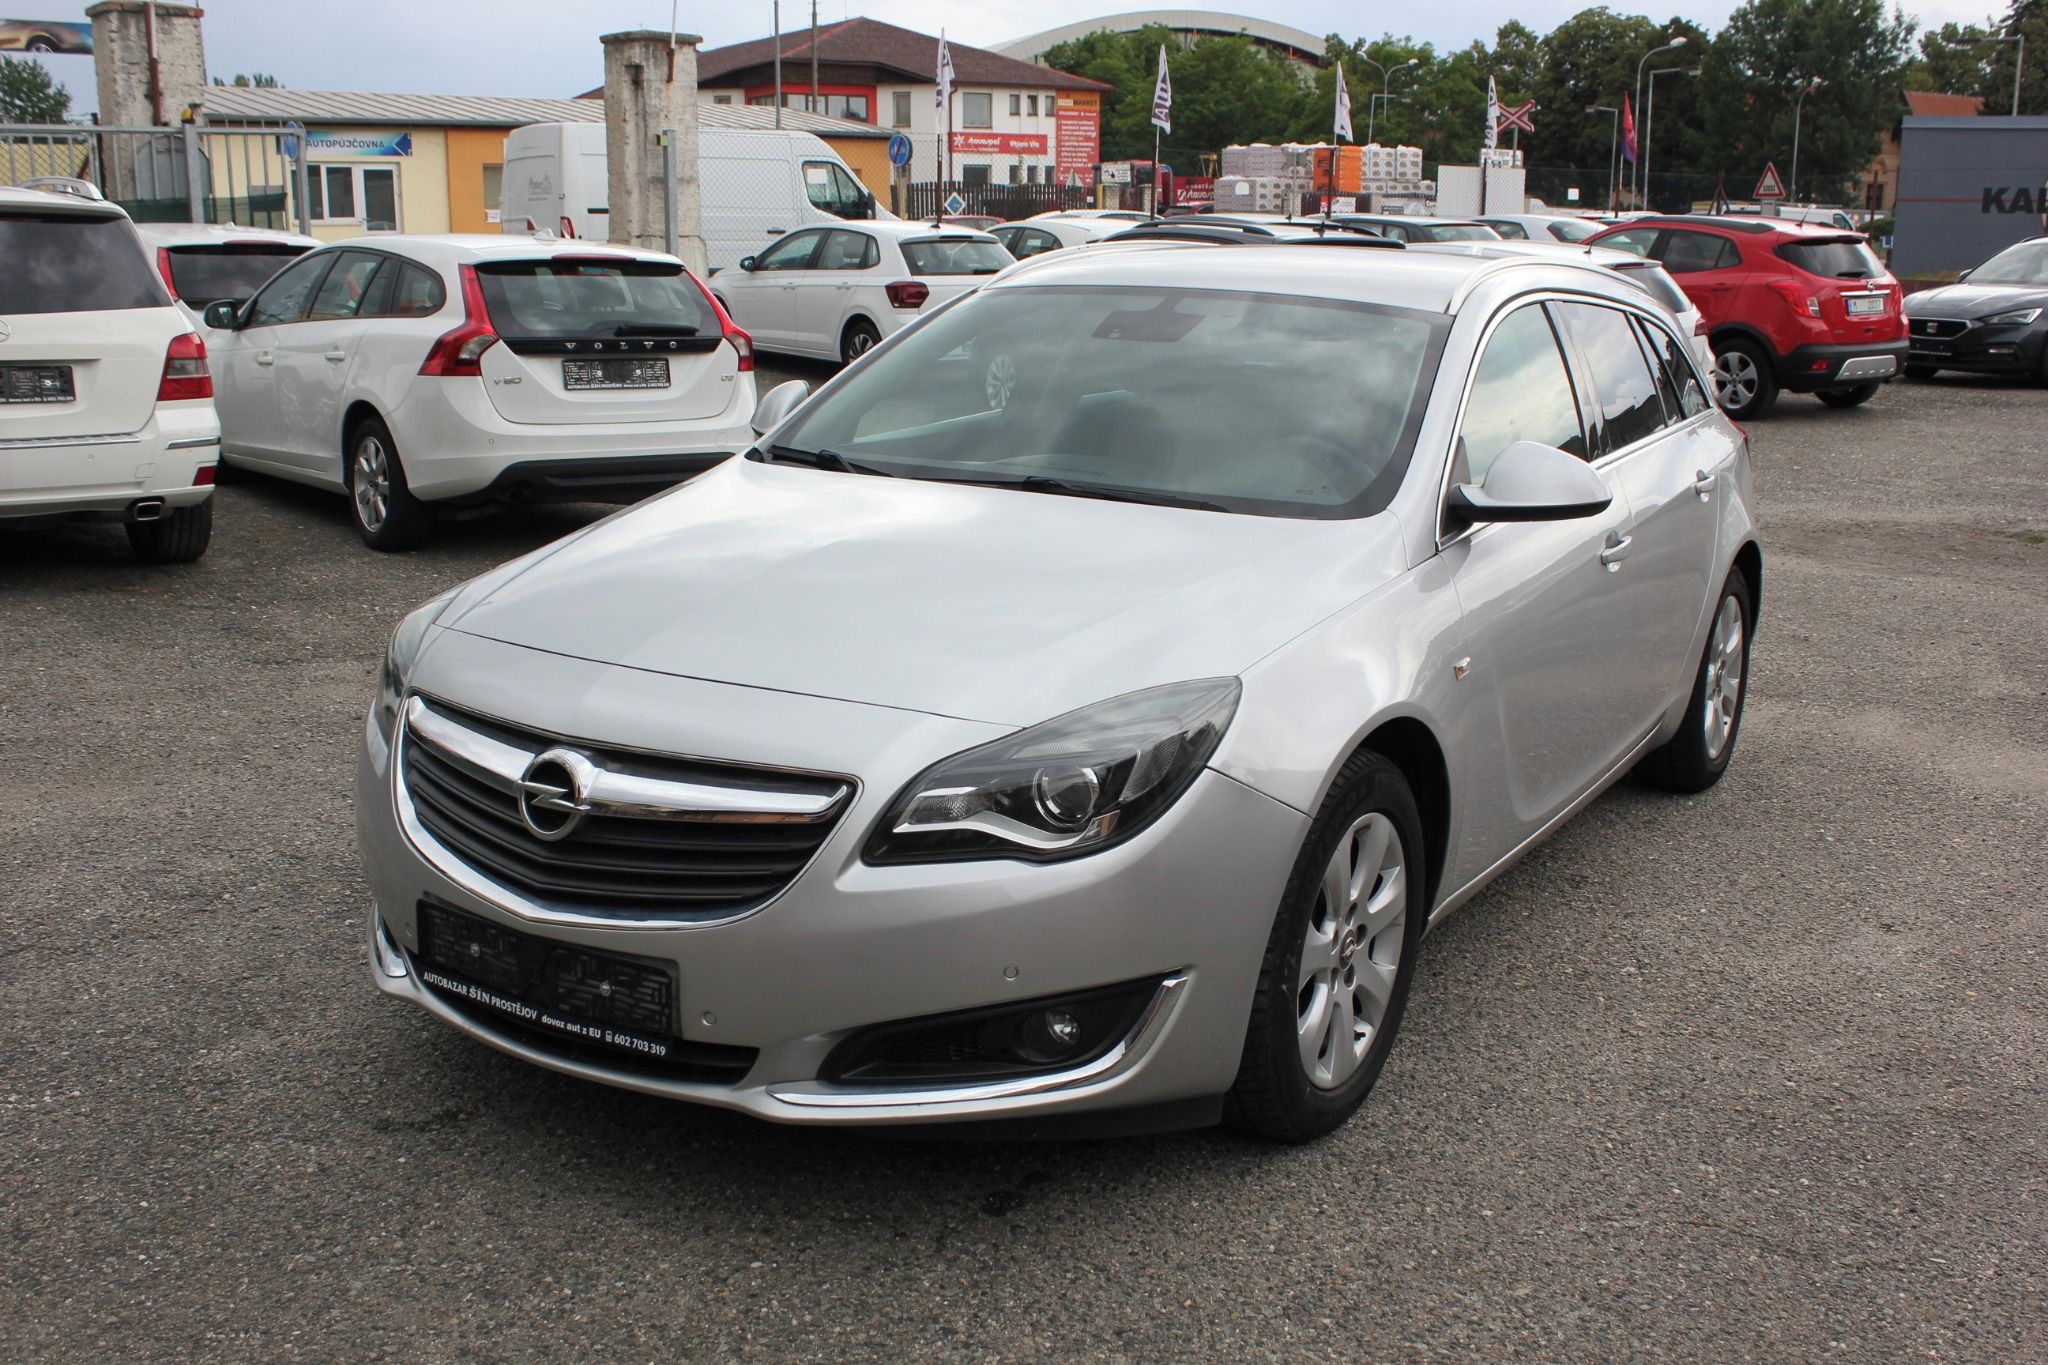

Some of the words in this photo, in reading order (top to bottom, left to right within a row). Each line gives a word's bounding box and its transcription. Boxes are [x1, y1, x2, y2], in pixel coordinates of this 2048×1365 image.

[564, 341, 677, 350] VOLVO
[424, 971, 468, 995] AUTOBAZAR
[469, 985, 490, 1004] ŠÍN
[491, 995, 538, 1020] PROSTĚJOV
[541, 1014, 565, 1028] dovoz
[566, 1022, 581, 1033] aut
[582, 1027, 588, 1035] z
[589, 1027, 601, 1038] EU
[614, 1033, 631, 1047] 602
[632, 1038, 649, 1052] 703
[650, 1044, 666, 1056] 319
